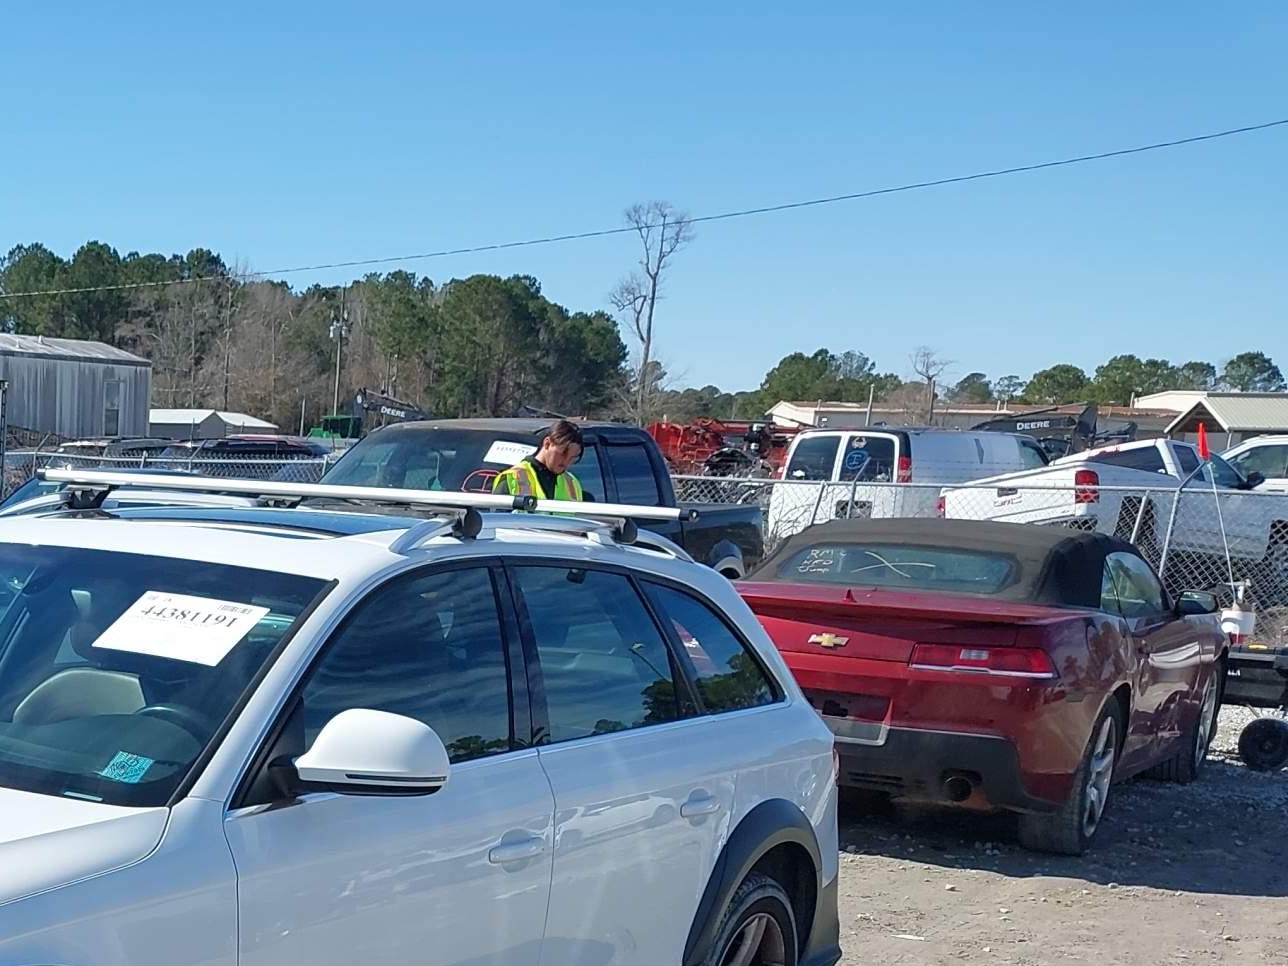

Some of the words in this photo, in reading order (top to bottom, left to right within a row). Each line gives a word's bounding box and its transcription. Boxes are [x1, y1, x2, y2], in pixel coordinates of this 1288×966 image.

[381, 405, 406, 418] DEERE
[1016, 420, 1050, 431] DEERE
[141, 605, 237, 627] 44381191
